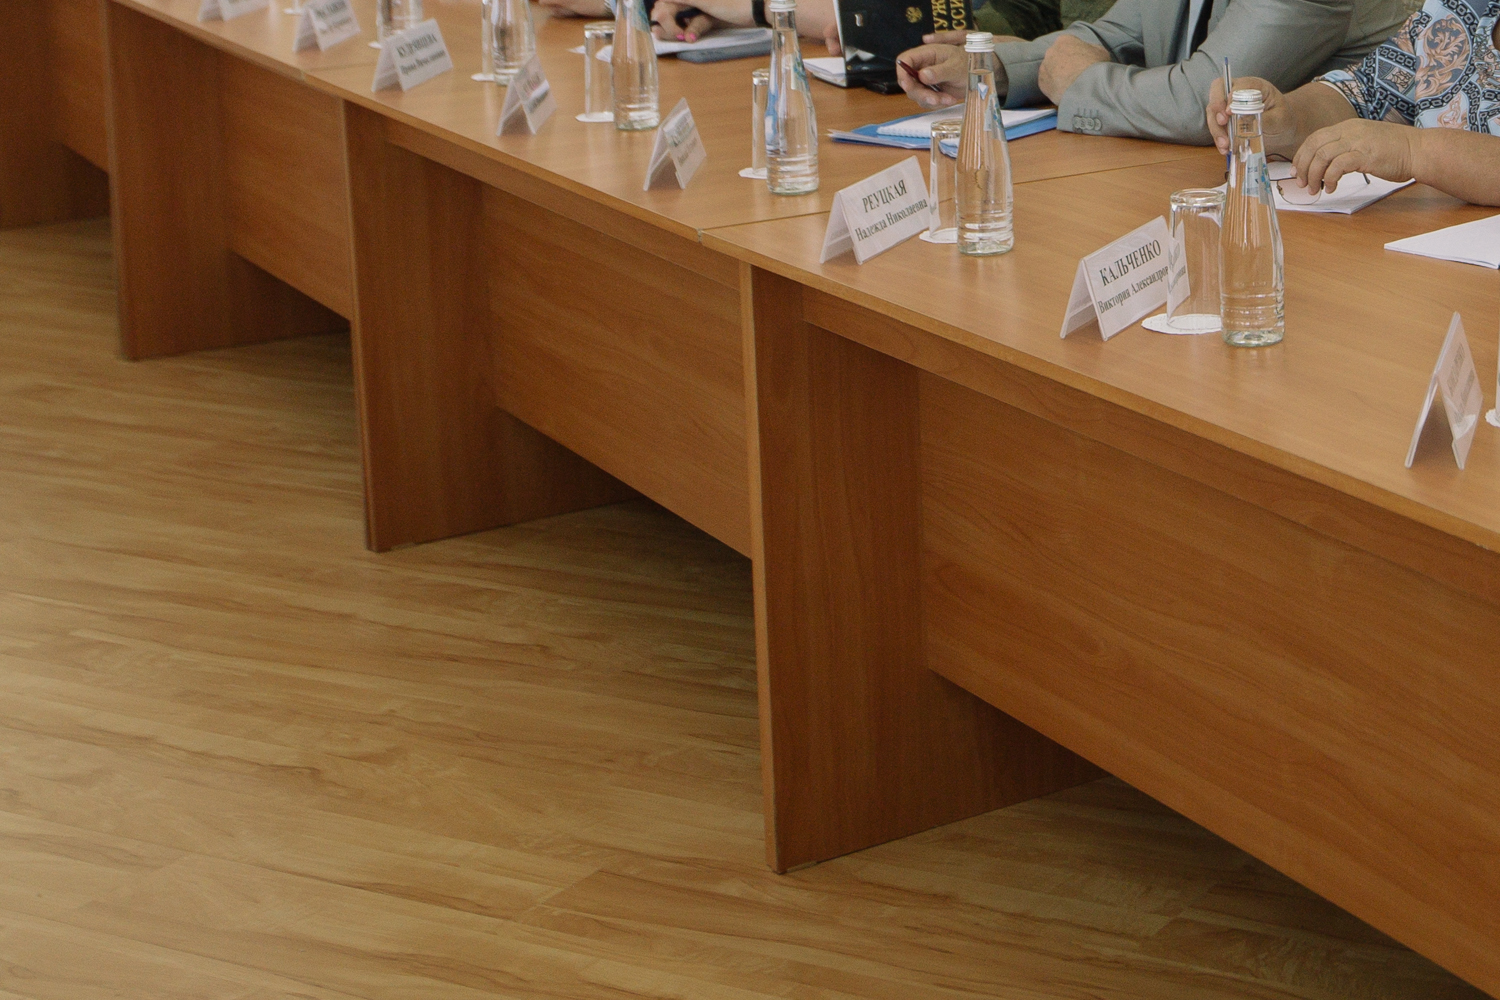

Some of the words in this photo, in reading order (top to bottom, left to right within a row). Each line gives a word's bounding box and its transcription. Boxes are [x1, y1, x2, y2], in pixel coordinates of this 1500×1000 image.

[862, 179, 907, 213] РЕУЦКАЯ
[855, 219, 888, 241] Надежда
[885, 199, 928, 226] Николаевна
[1099, 239, 1161, 287] КАЛЬЧЕНКО
[1097, 288, 1131, 314] Виктория
[1130, 265, 1169, 296] Александров
